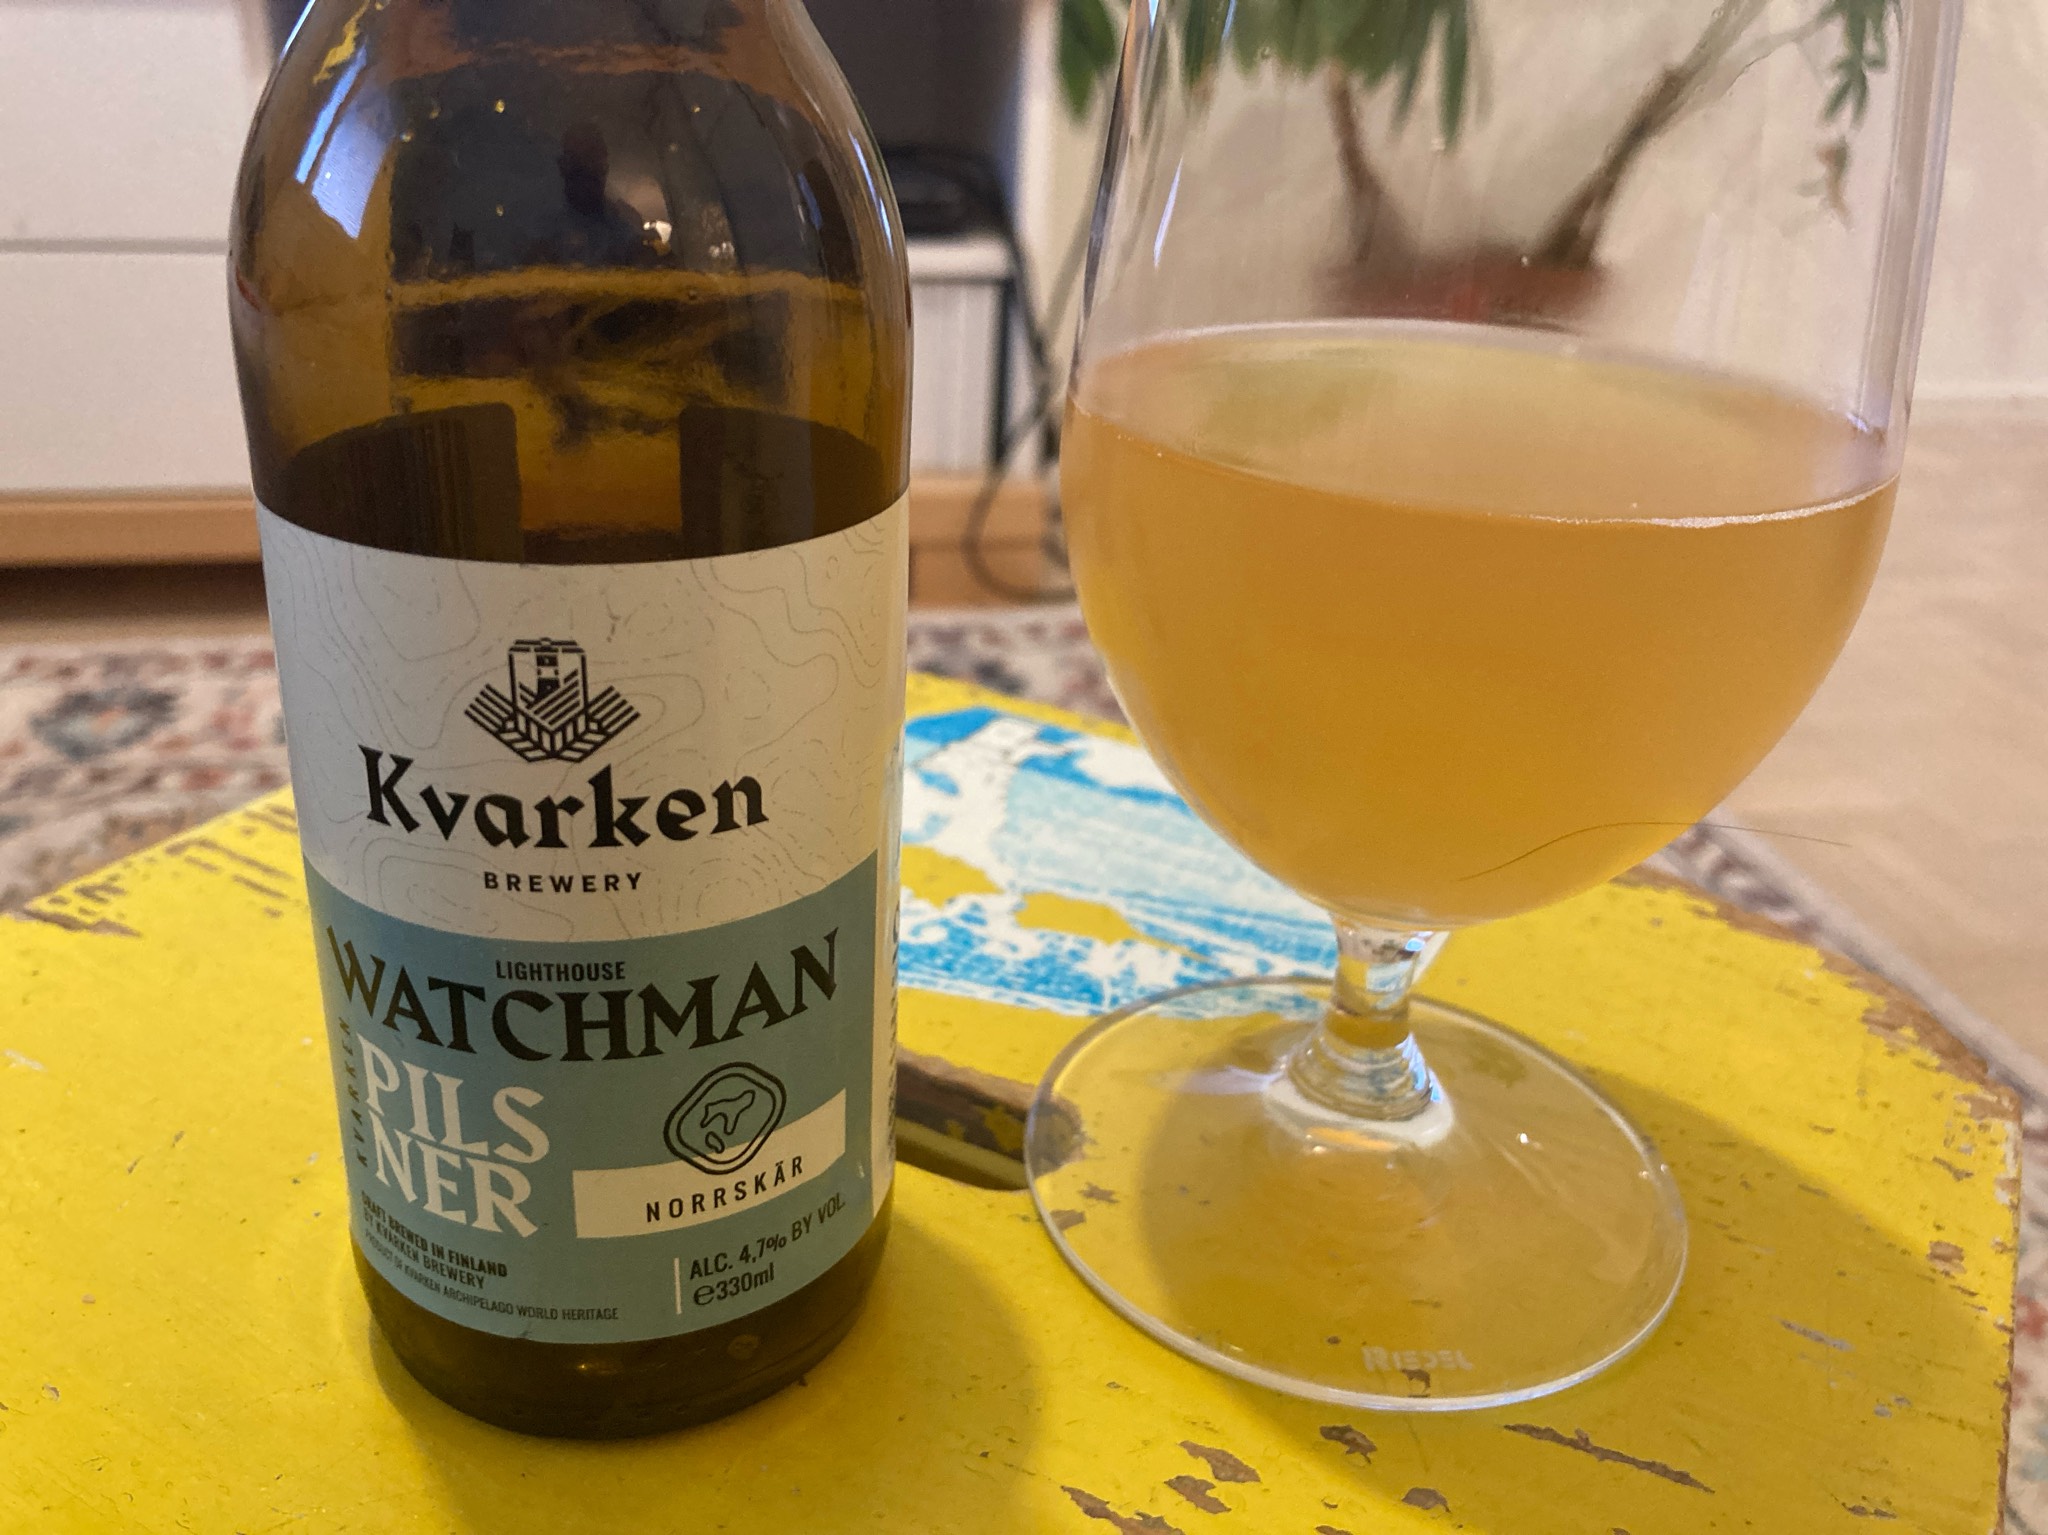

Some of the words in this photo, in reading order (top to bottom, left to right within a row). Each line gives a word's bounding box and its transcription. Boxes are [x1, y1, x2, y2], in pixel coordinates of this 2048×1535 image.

[358, 744, 769, 848] Kvarken
[483, 871, 642, 893] BREWERY
[327, 925, 839, 1062] WATCHMAN
[496, 960, 626, 982] LIGHTHOUSE
[356, 1032, 550, 1164] PILS
[368, 1109, 539, 1238] NER
[646, 1156, 803, 1223] NORRSKÄR
[388, 1215, 428, 1252] BREWED
[431, 1241, 445, 1260] IN
[448, 1248, 508, 1278] FINLAND
[423, 1255, 484, 1290] BREWERY
[690, 1253, 734, 1280] ALC.
[738, 1233, 787, 1265] 4,7%
[791, 1214, 813, 1242] BY
[404, 1265, 442, 1295] KVARKEN
[443, 1285, 514, 1315] ARCHIPELAGO
[516, 1304, 558, 1321] WORLD
[561, 1307, 619, 1321] HERITAGE
